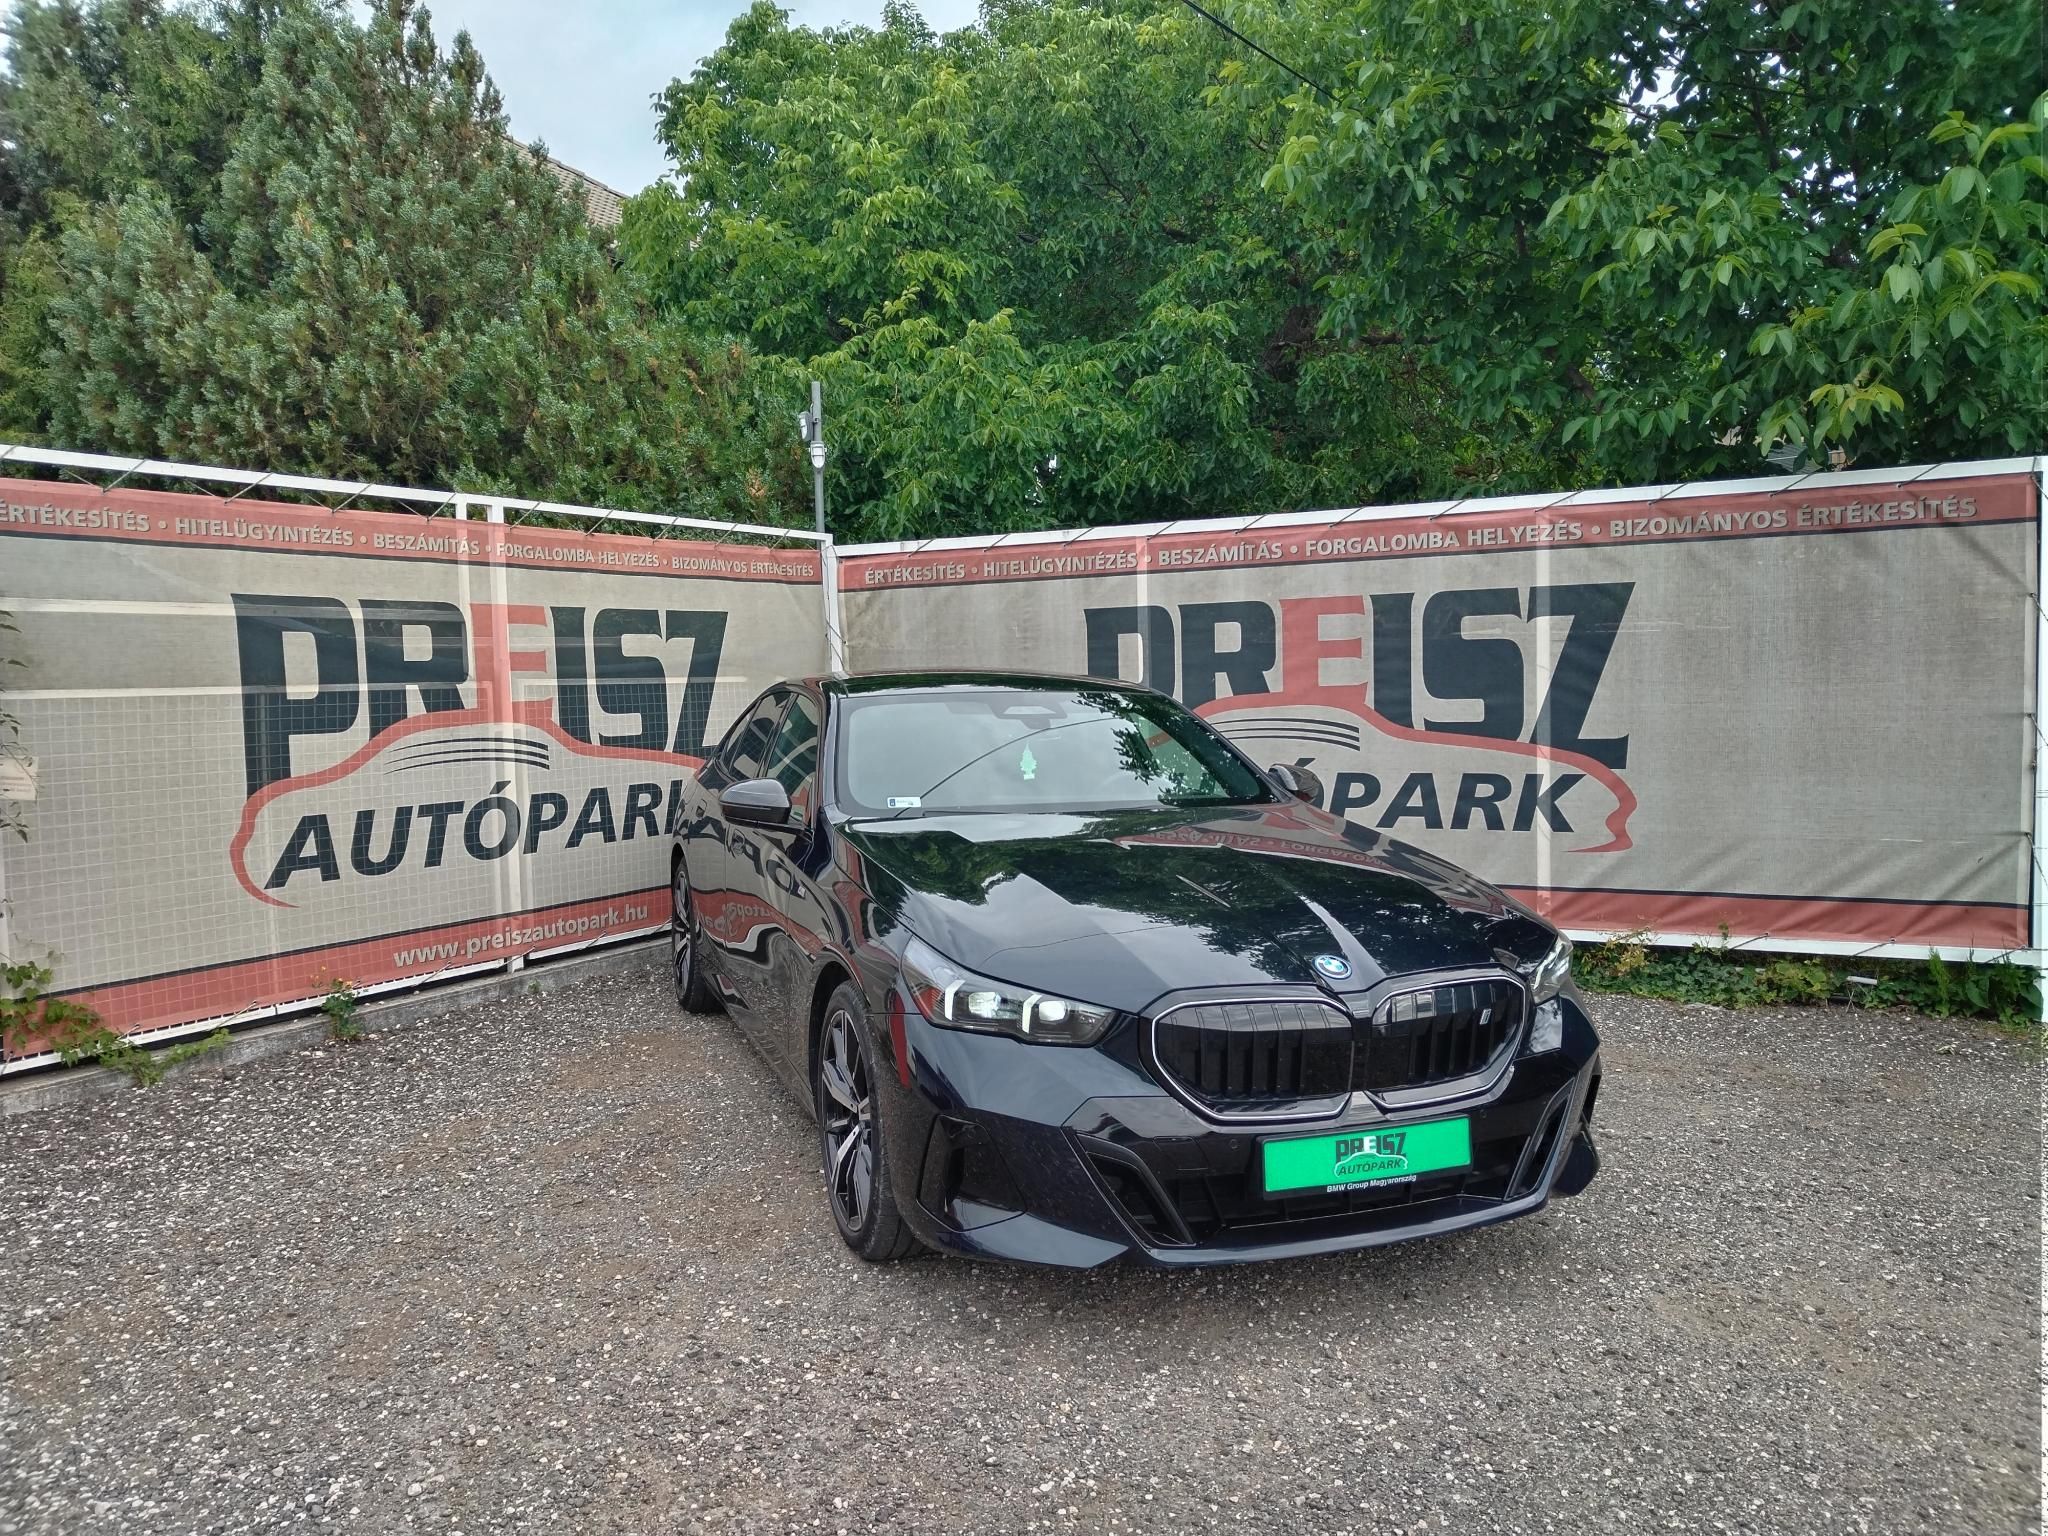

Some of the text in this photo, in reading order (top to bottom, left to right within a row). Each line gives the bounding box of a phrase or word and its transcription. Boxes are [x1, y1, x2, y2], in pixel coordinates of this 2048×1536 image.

[175, 516, 354, 547] HITELÜGYINTÉZÉS
[373, 532, 480, 555] BESZÁMÍTÁS
[496, 541, 595, 564] FORGALOMBA
[599, 549, 660, 569] HELYEZÉS
[672, 554, 748, 574] BIZOMÁNYOS
[750, 559, 814, 578] ÉRTÉKESÍTÉS
[864, 494, 1977, 586] ÉRTÉKESÍTÉS HITELÜGYINTÉZÉS BESZÁMÍTÁS FORGALOMBA HELYEZÉS BIZOMÁNYOS ÉRTÉKESÍTÉS
[231, 593, 729, 799] PREISZ
[393, 903, 648, 968] www.preiszautopark.hu
[1335, 1132, 1407, 1164] PREISZ
[1326, 1174, 1417, 1193] BMW Group Magyarország
